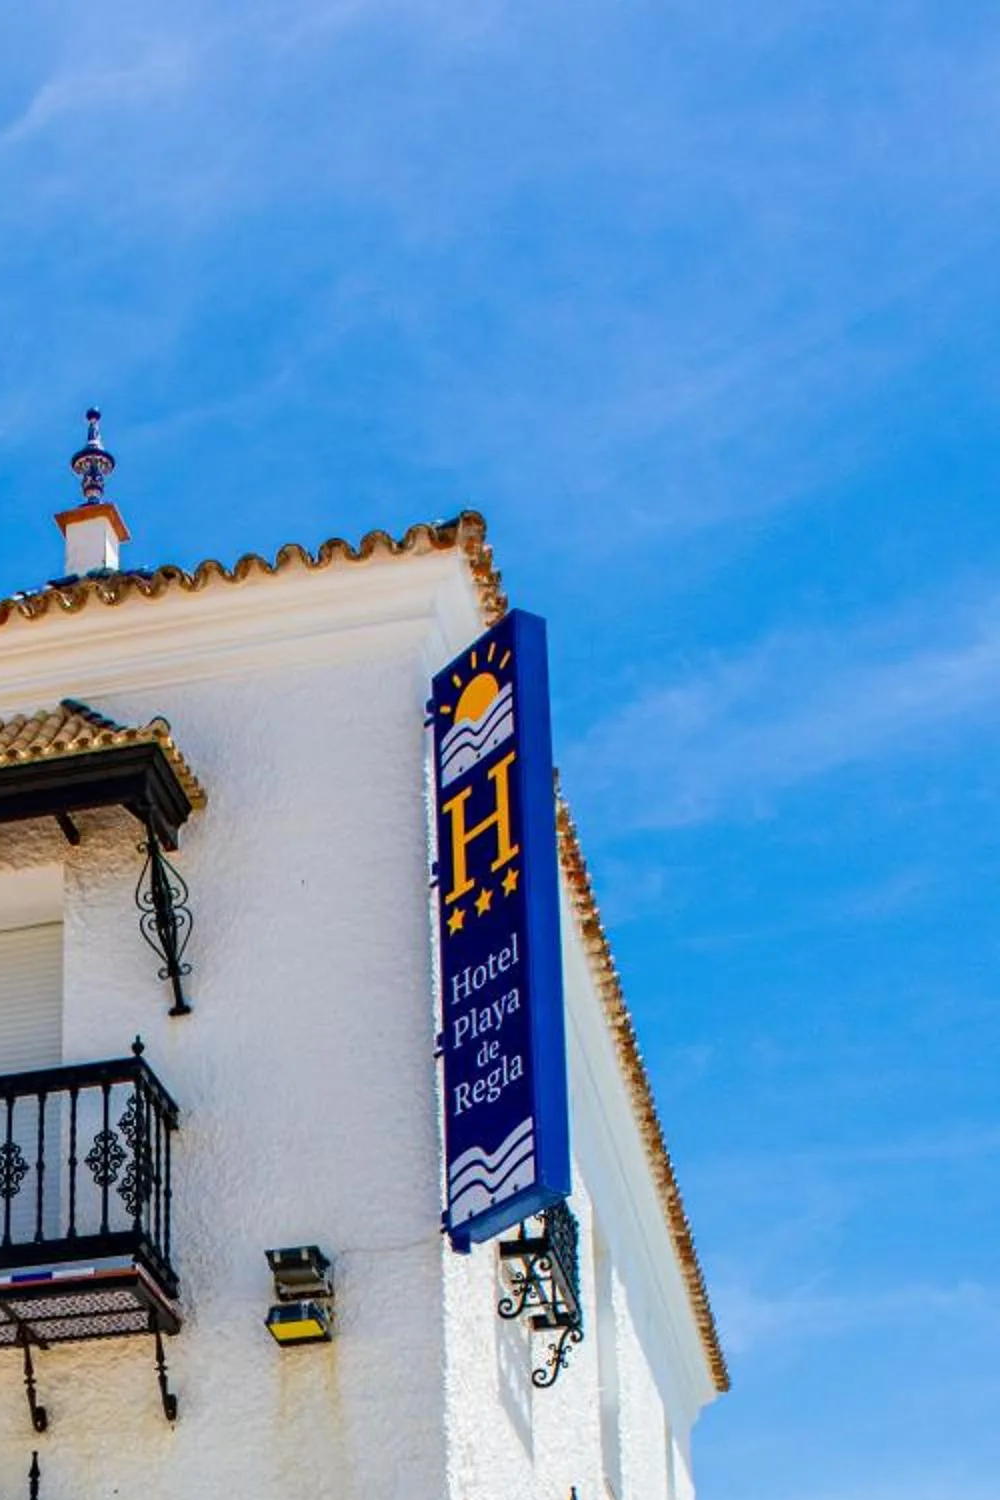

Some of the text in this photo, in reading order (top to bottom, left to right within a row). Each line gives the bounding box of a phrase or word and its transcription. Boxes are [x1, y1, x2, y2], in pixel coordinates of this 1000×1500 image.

[442, 750, 519, 905] H
[450, 932, 519, 1005] Hotel
[452, 986, 521, 1049] Playa
[476, 1039, 501, 1067] de
[453, 1054, 524, 1117] Regla
